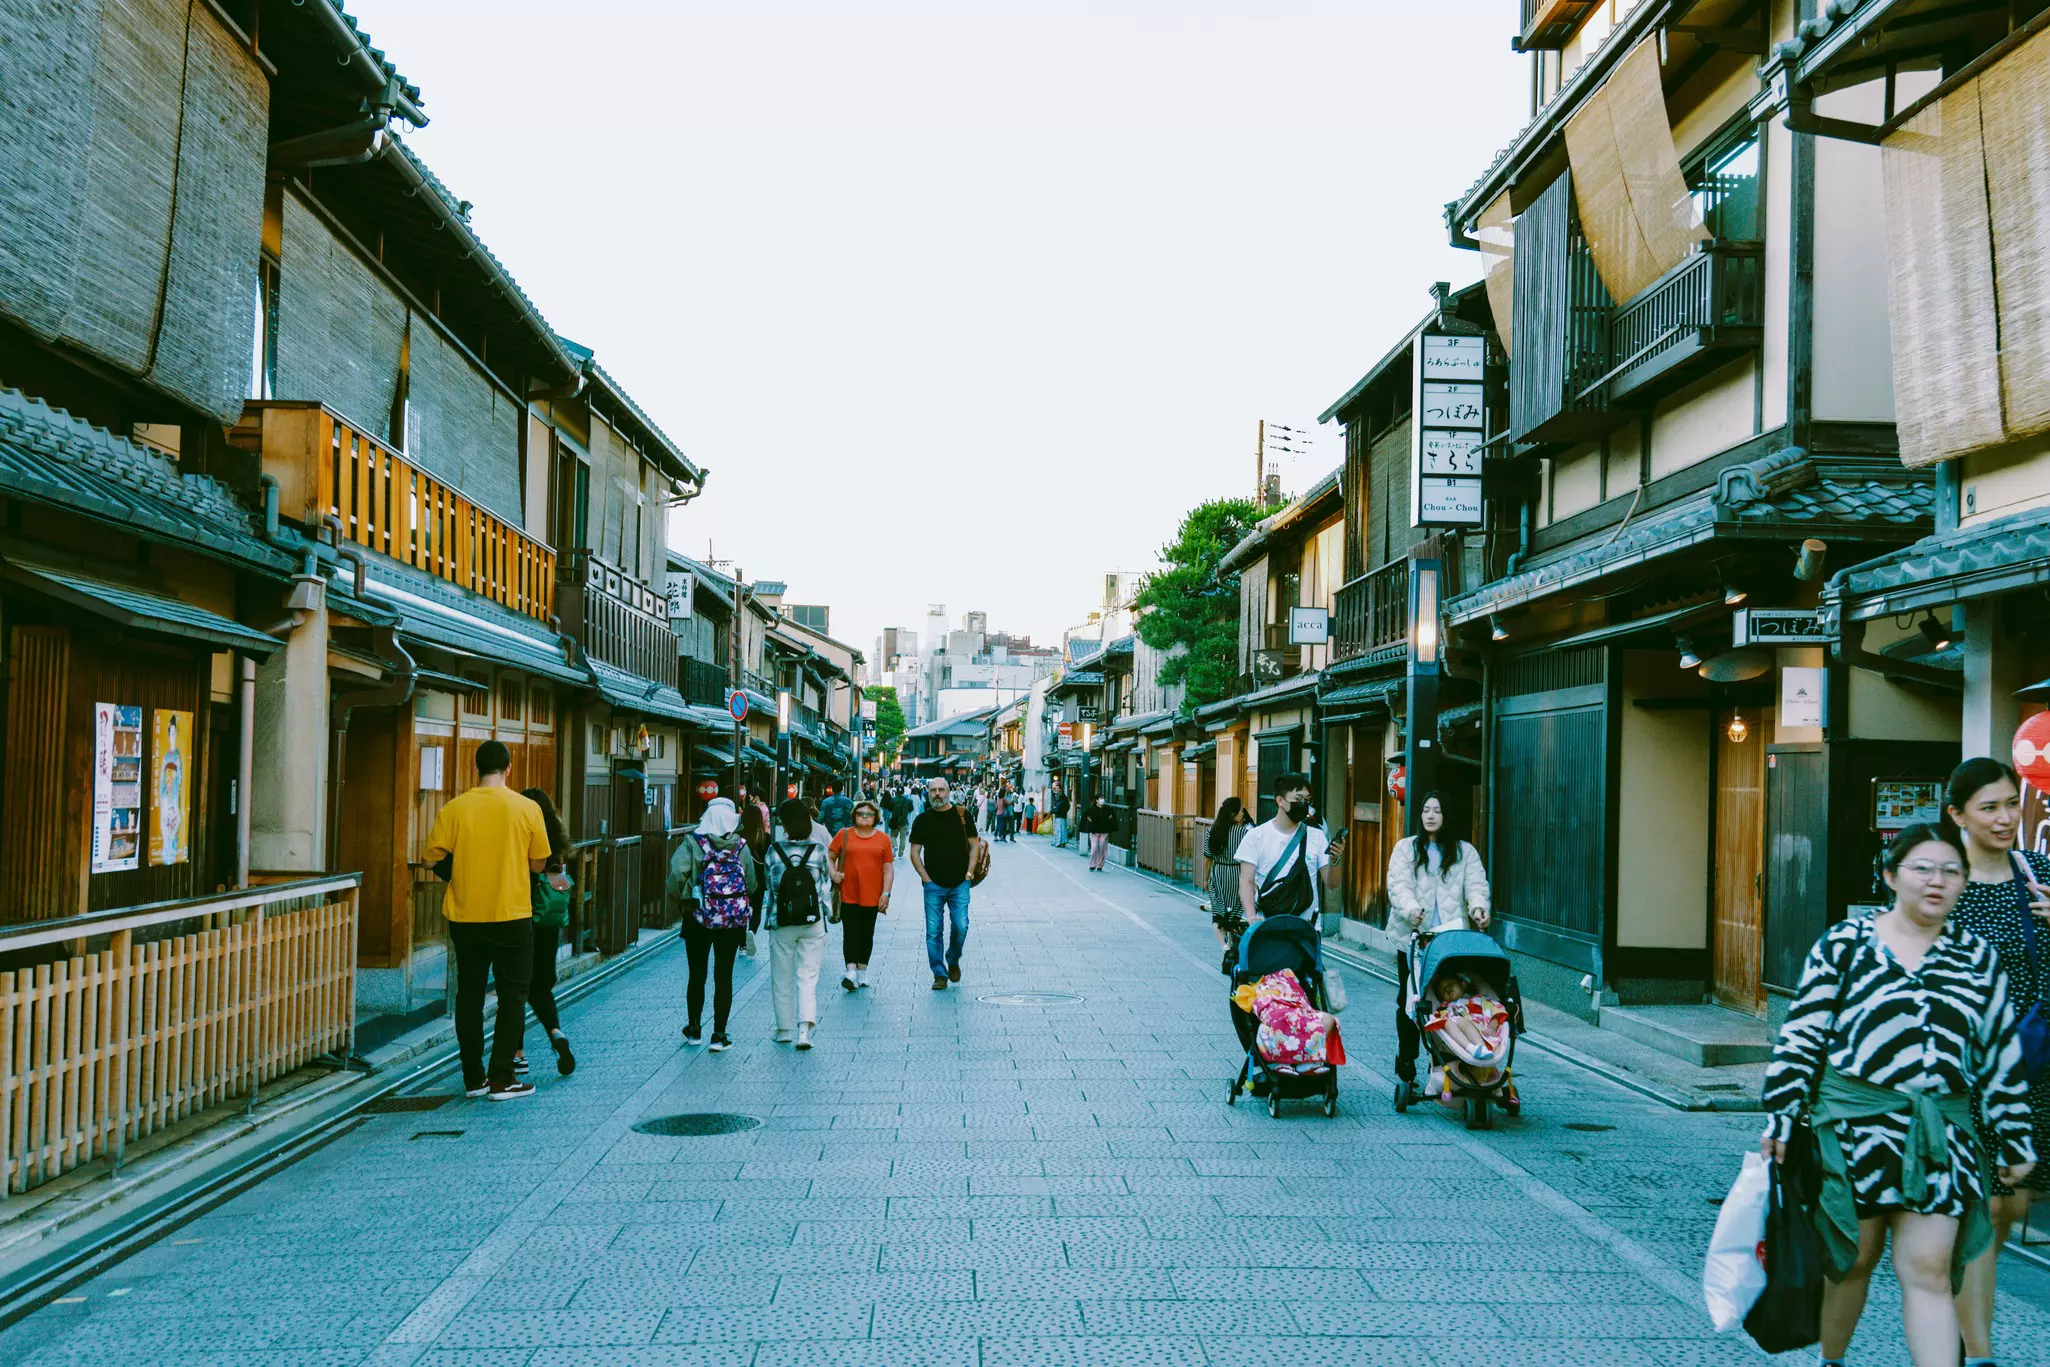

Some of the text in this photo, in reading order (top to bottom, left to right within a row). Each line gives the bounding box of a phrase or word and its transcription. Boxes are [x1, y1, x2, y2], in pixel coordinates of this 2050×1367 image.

[1447, 338, 1459, 347] 3F
[1427, 405, 1479, 420] つぼみ
[1449, 431, 1457, 439] 1F
[1447, 479, 1456, 487] B1
[1424, 503, 1446, 511] Chou
[1456, 504, 1477, 512] Chou
[1298, 621, 1322, 630] acca
[1761, 618, 1820, 634] つぼみ
